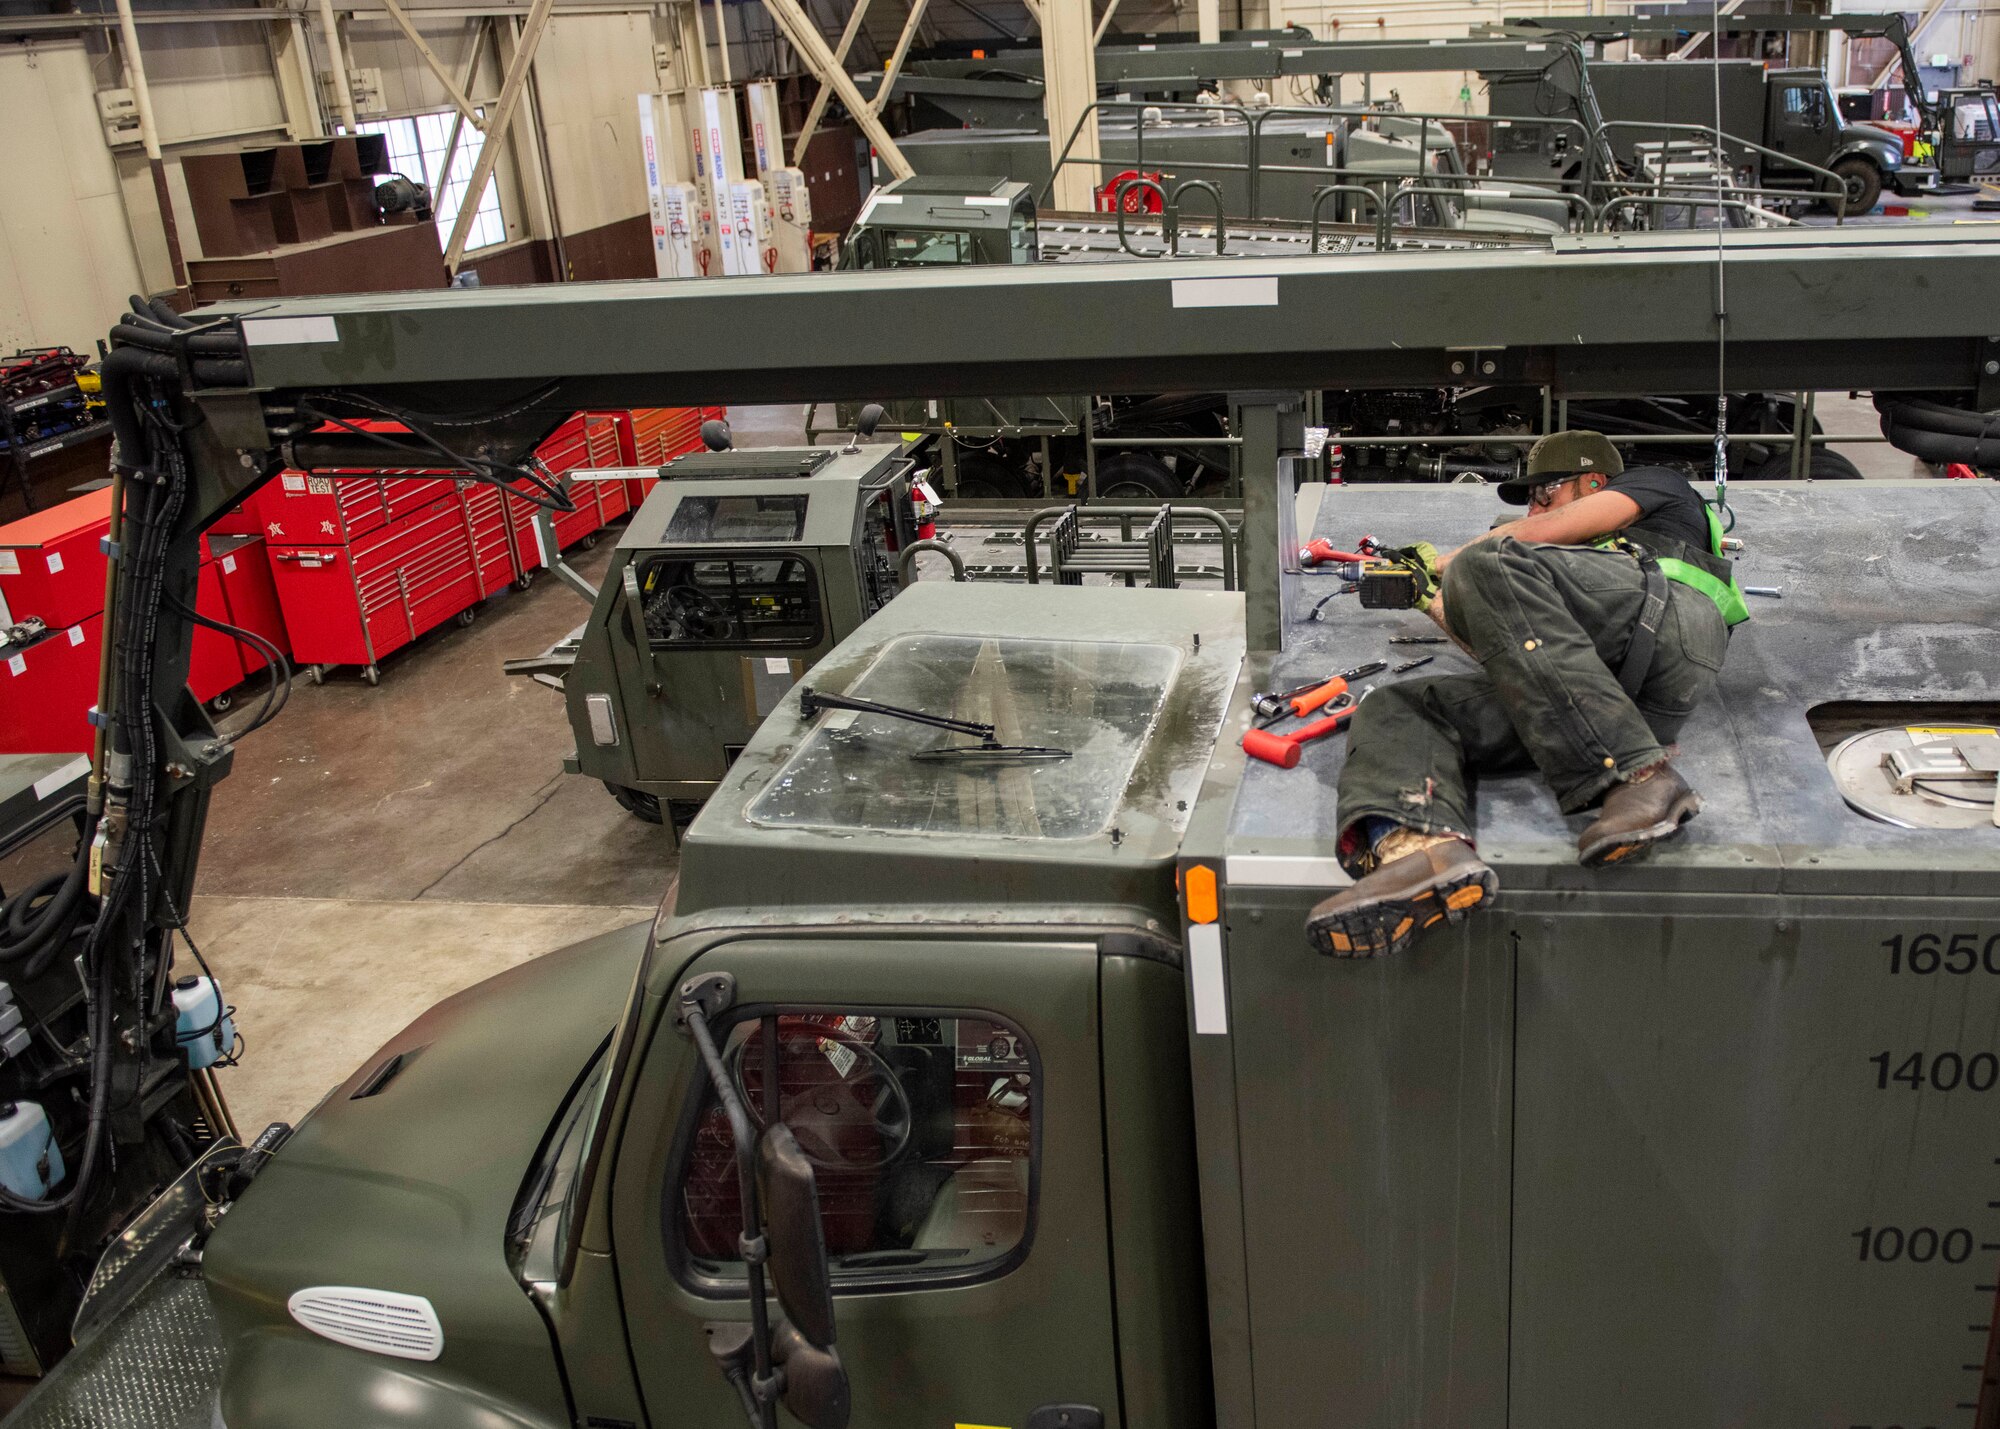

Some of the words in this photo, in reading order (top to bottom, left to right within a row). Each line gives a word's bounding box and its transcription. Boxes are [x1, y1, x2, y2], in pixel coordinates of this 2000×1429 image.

[308, 477, 329, 485] ROAD
[311, 485, 329, 493] TEST
[1869, 1051, 2000, 1092] 1400
[1851, 1226, 1974, 1264] 1000
